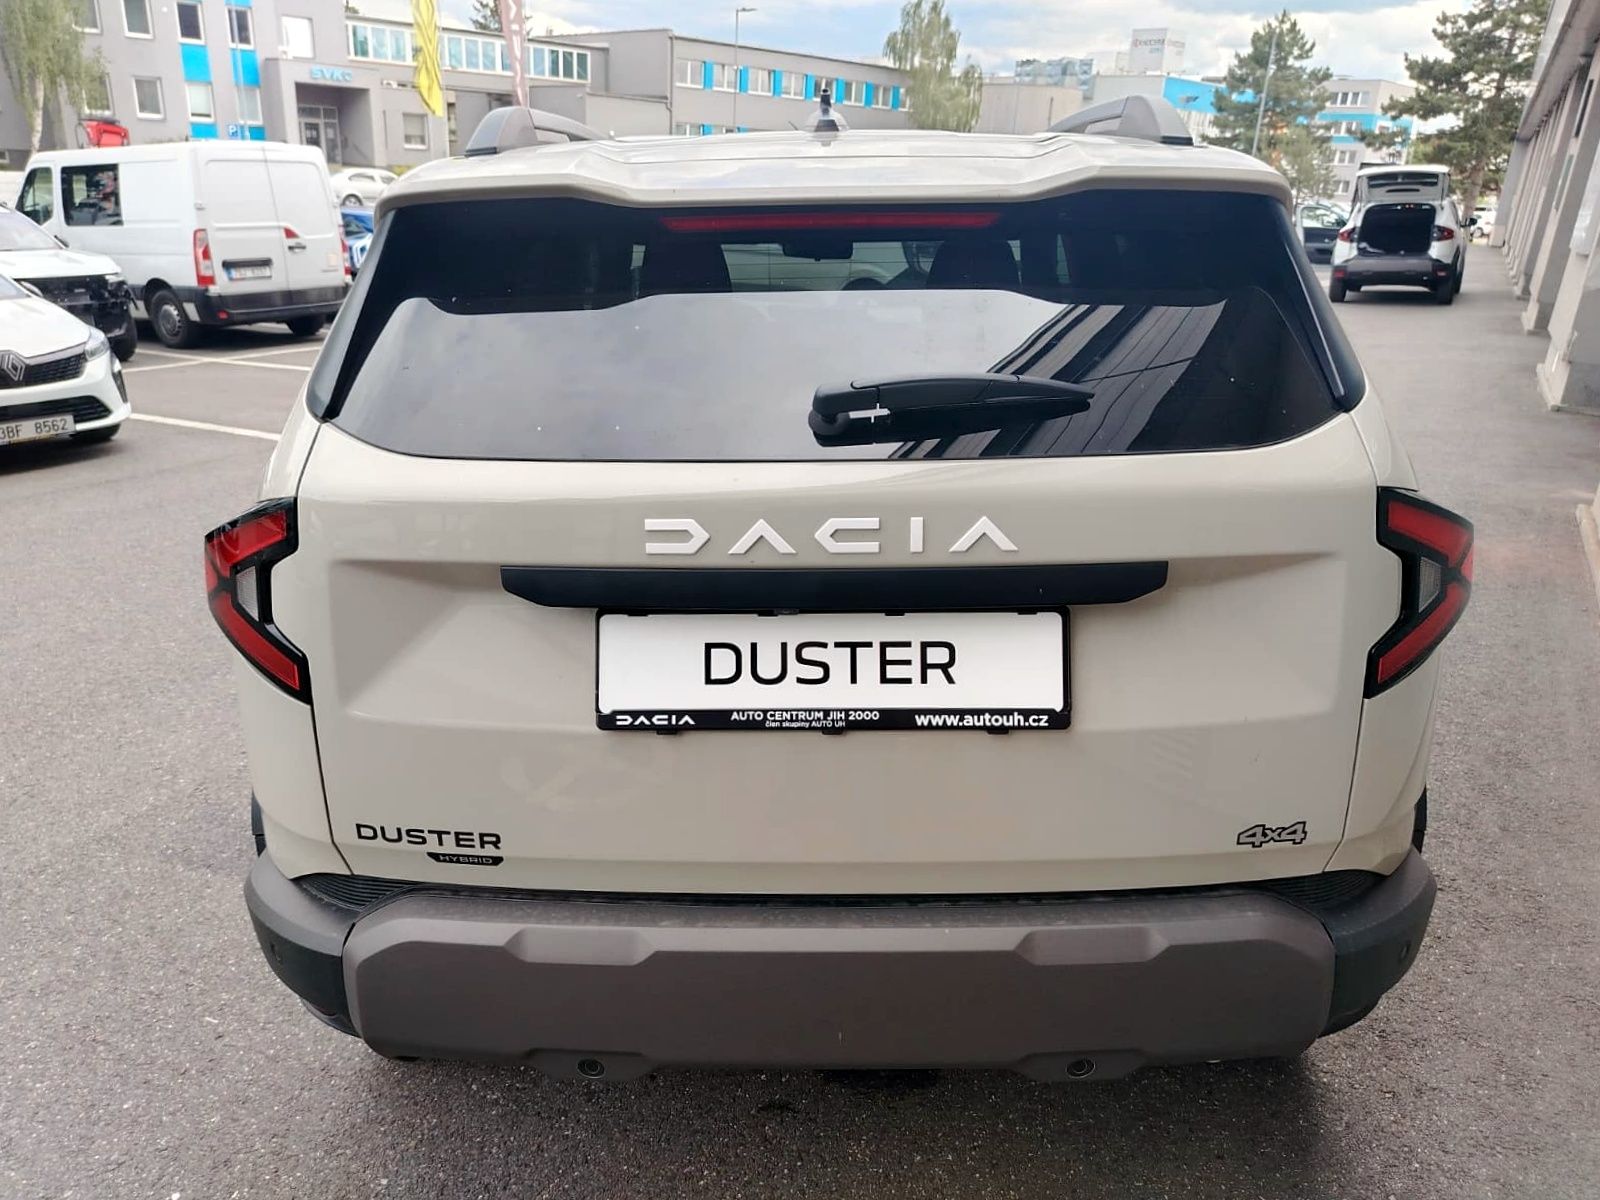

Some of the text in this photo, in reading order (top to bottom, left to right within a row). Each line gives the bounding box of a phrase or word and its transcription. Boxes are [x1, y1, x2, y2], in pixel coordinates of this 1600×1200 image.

[34, 418, 68, 434] 8562
[644, 515, 1019, 555] DACIA
[704, 640, 956, 685] DUSTER
[615, 714, 697, 726] DACIA
[730, 710, 880, 721] AUTO CENTRUM JIH 2000
[914, 711, 1049, 727] www.autouh.cz
[811, 720, 832, 728] AUTO
[834, 720, 846, 728] UH
[355, 823, 502, 850] DUSTER
[1236, 821, 1308, 848] 4x4
[438, 855, 494, 864] HYBRID
